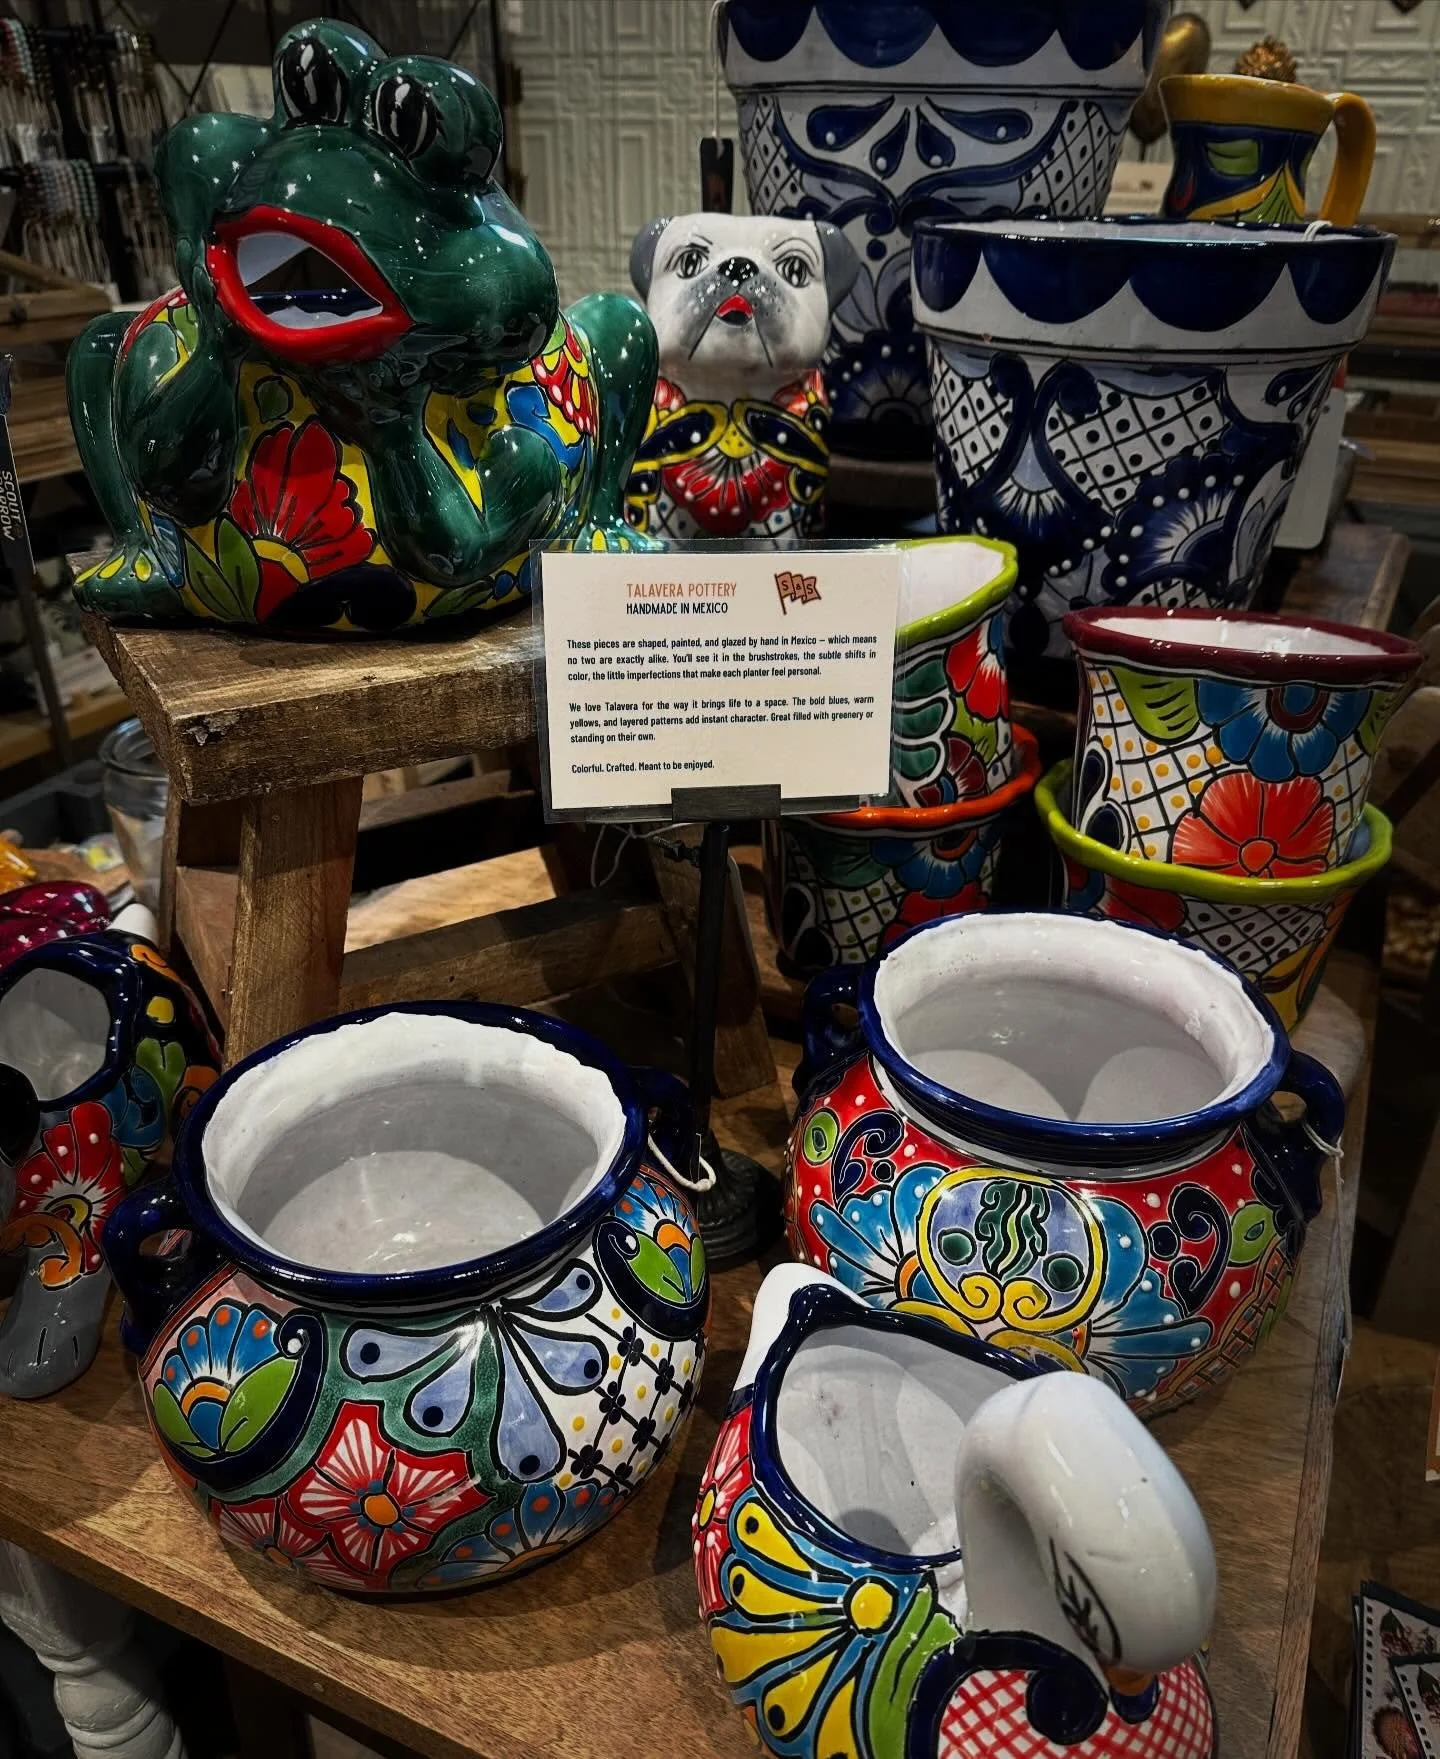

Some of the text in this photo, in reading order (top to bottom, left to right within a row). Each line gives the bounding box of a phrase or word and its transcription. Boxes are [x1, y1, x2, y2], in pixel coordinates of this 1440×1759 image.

[2, 470, 21, 523] SCOUT
[626, 583, 737, 598] TALAVERA POTTERY
[782, 580, 789, 591] S
[806, 584, 814, 594] S
[626, 602, 729, 615] HANDMADE IN MEXICO
[566, 640, 591, 649] These
[593, 638, 620, 651] pieces
[622, 640, 636, 649] are
[637, 638, 669, 650] shaped,
[670, 637, 702, 650] painted,
[704, 637, 720, 647] and
[721, 636, 747, 649] glazed
[748, 636, 758, 649] by
[760, 636, 779, 646] hand
[781, 636, 789, 646] in
[790, 635, 817, 646] Mexico
[827, 634, 850, 645] which
[852, 636, 877, 644] means
[580, 656, 596, 665] two
[599, 656, 613, 665] are
[616, 654, 645, 666] exactly
[648, 654, 669, 664] alike.
[713, 652, 719, 663] it
[722, 652, 730, 662] in
[732, 652, 746, 662] the
[748, 650, 800, 662] brushstrokes,
[803, 651, 816, 660] the
[818, 650, 842, 660] subtle
[844, 650, 866, 660] shifts
[869, 649, 876, 659] in
[567, 666, 822, 682] color, the little imperfections that make each planter feel personal.
[568, 702, 582, 712] We
[584, 703, 602, 712] love
[604, 702, 639, 712] Talavera
[641, 701, 654, 711] for
[656, 700, 670, 710] the
[673, 702, 689, 712] way
[692, 699, 698, 709] it
[701, 699, 726, 711] brings
[728, 698, 742, 708] life
[744, 699, 753, 708] to
[764, 699, 789, 709] space.
[792, 697, 806, 706] The
[809, 696, 826, 706] bold
[828, 696, 850, 705] blues,
[569, 718, 601, 730] yellows,
[603, 717, 618, 727] and
[620, 716, 649, 729] layered
[650, 717, 684, 728] patterns
[685, 715, 700, 725] add
[701, 715, 728, 724] instant
[730, 714, 769, 723] character.
[770, 713, 791, 722] Great
[792, 712, 812, 721] filled
[813, 711, 830, 720] with
[831, 712, 864, 722] greenery
[570, 732, 605, 745] standing
[617, 732, 637, 742] their
[571, 760, 715, 774] Colorful. Crafted. Meant to be enjoyed.
